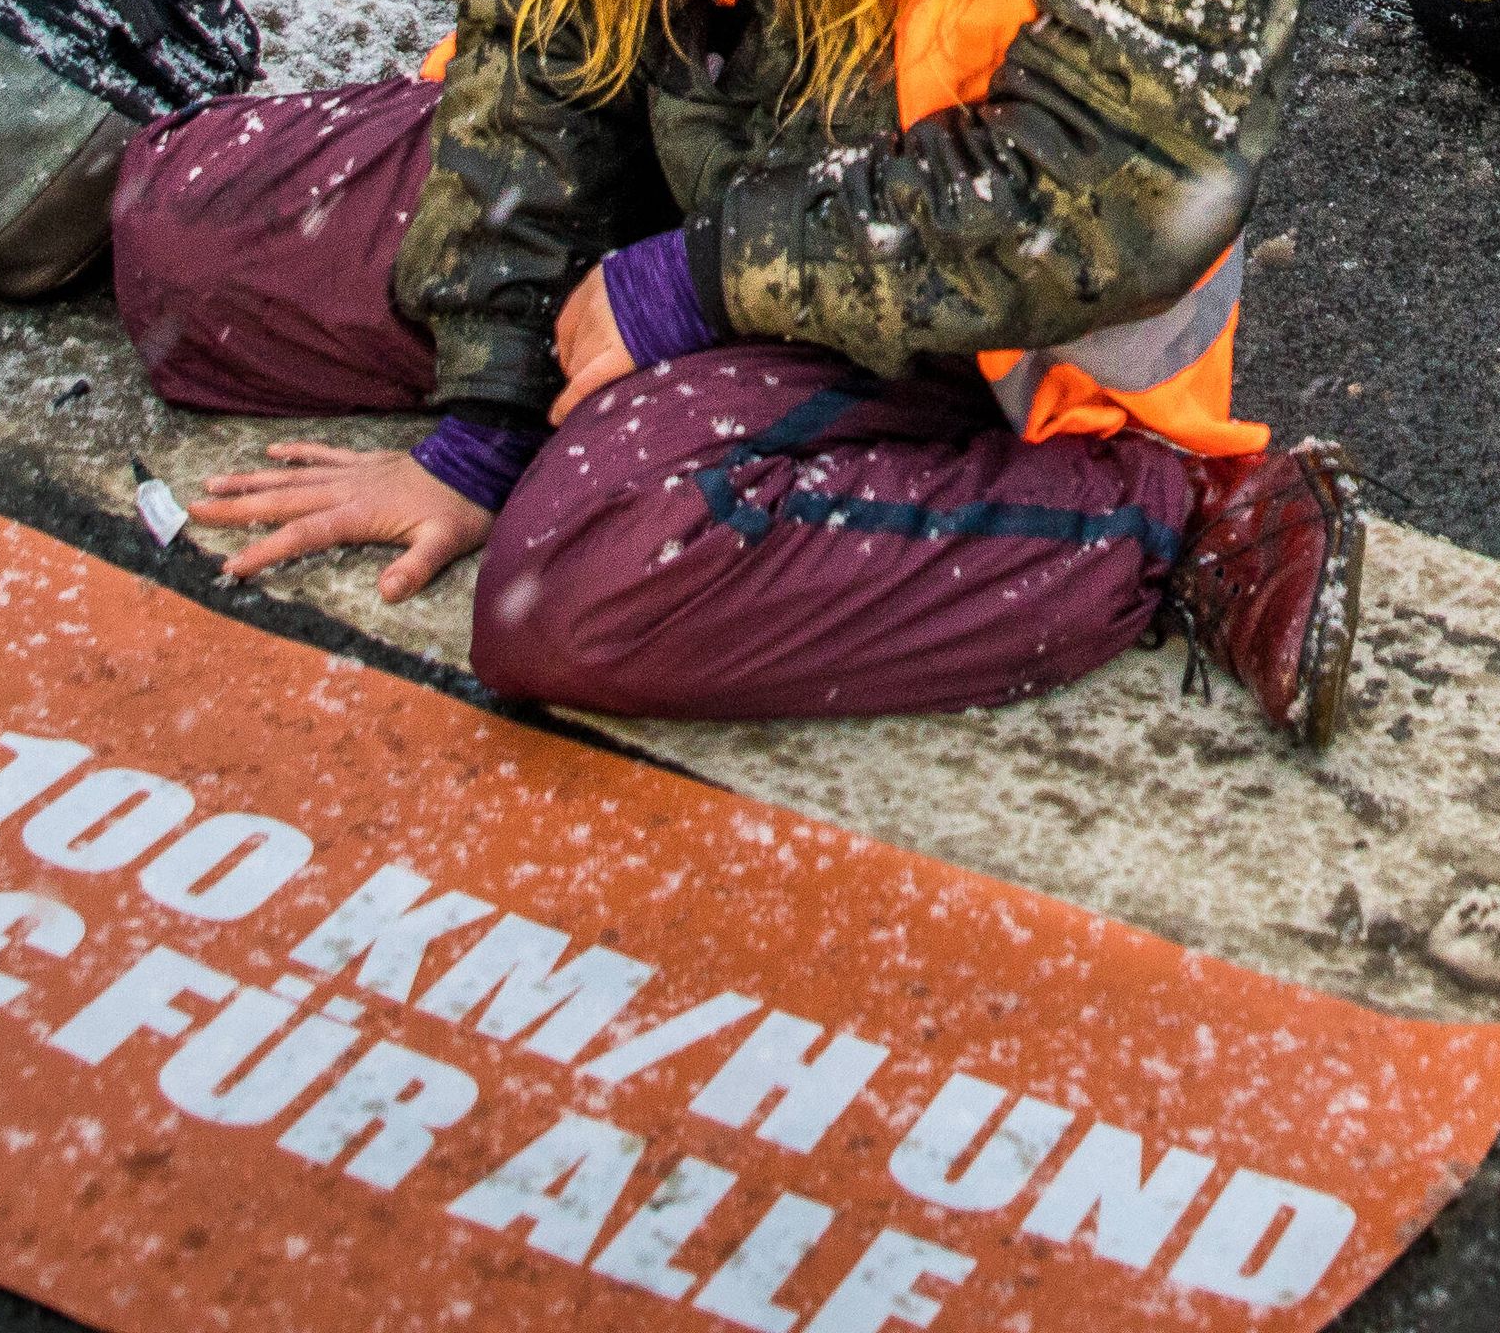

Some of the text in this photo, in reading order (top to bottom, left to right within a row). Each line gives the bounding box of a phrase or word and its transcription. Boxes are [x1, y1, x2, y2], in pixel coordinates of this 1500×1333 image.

[47, 946, 479, 1192] FÜR
[445, 1112, 978, 1333] ALLE
[289, 864, 890, 1154] KM/H
[888, 1072, 1357, 1309] UND
